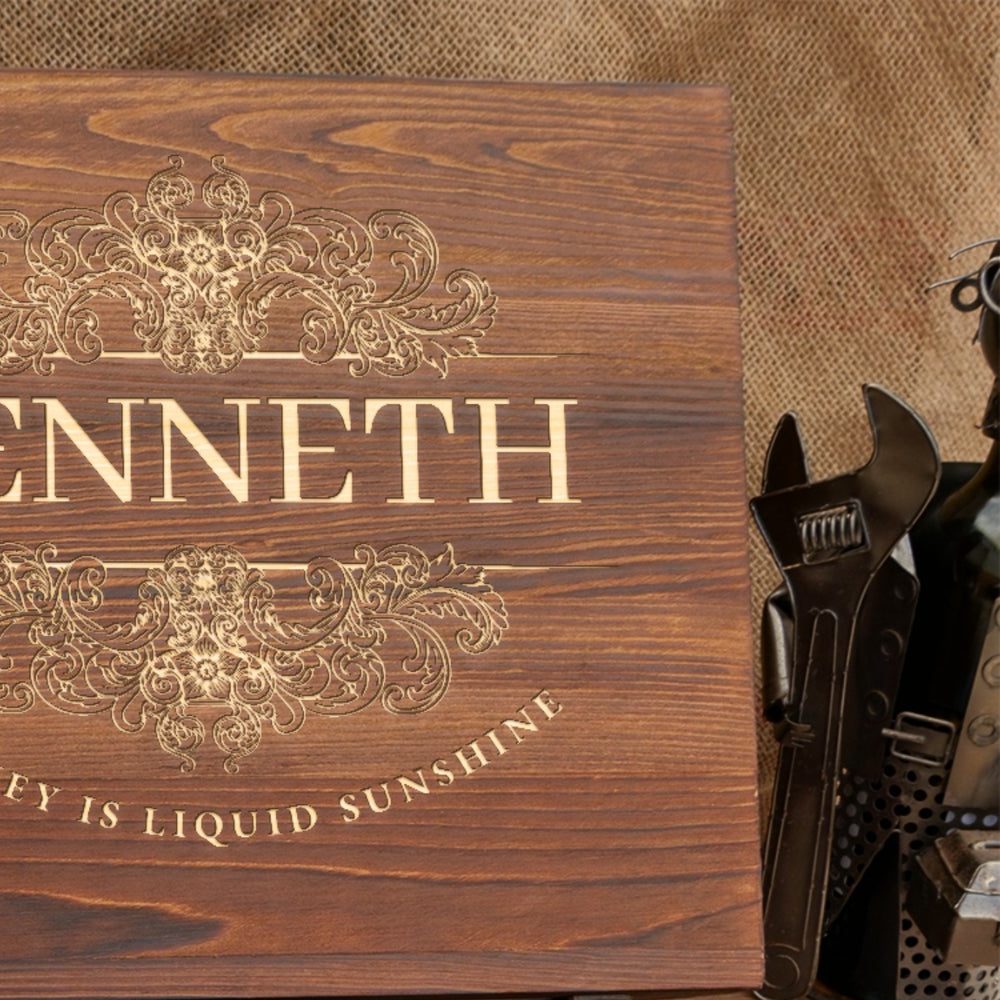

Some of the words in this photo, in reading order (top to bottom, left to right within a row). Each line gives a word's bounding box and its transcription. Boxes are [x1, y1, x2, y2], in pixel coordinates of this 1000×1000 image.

[78, 796, 120, 828] IS
[143, 804, 318, 847] LIQUID
[339, 689, 563, 822] SUNSHINE
